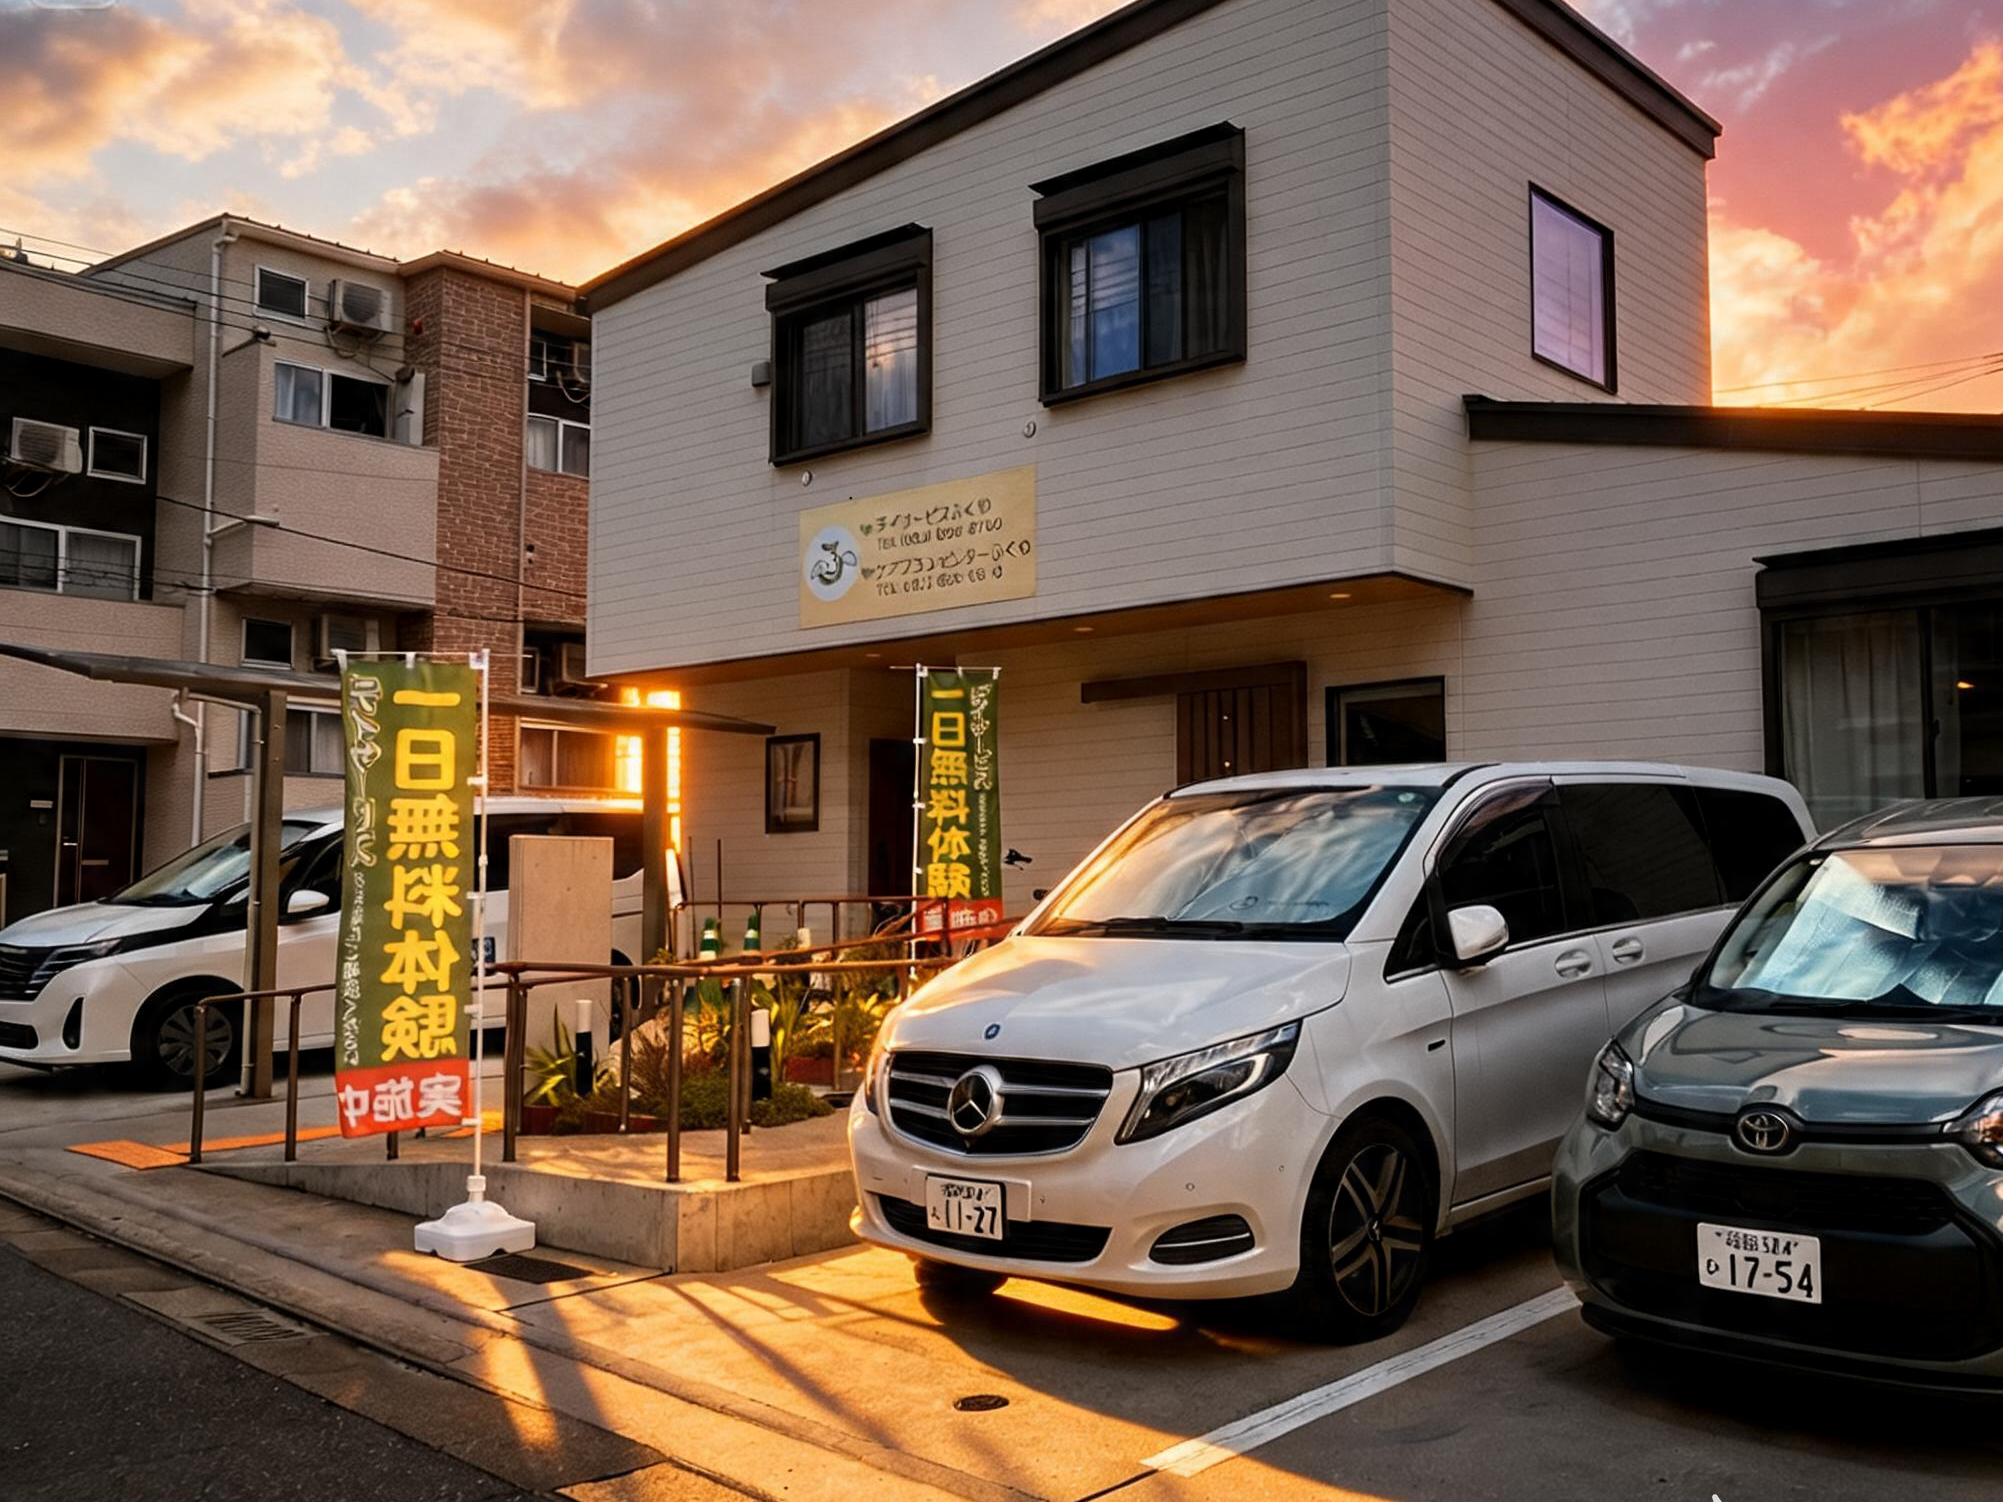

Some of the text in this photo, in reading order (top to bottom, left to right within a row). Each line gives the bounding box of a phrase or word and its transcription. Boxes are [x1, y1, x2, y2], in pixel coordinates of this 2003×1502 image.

[926, 689, 971, 899] 一日無料体験
[945, 1198, 997, 1235] 11-27
[1729, 1253, 1813, 1299] 17-54
